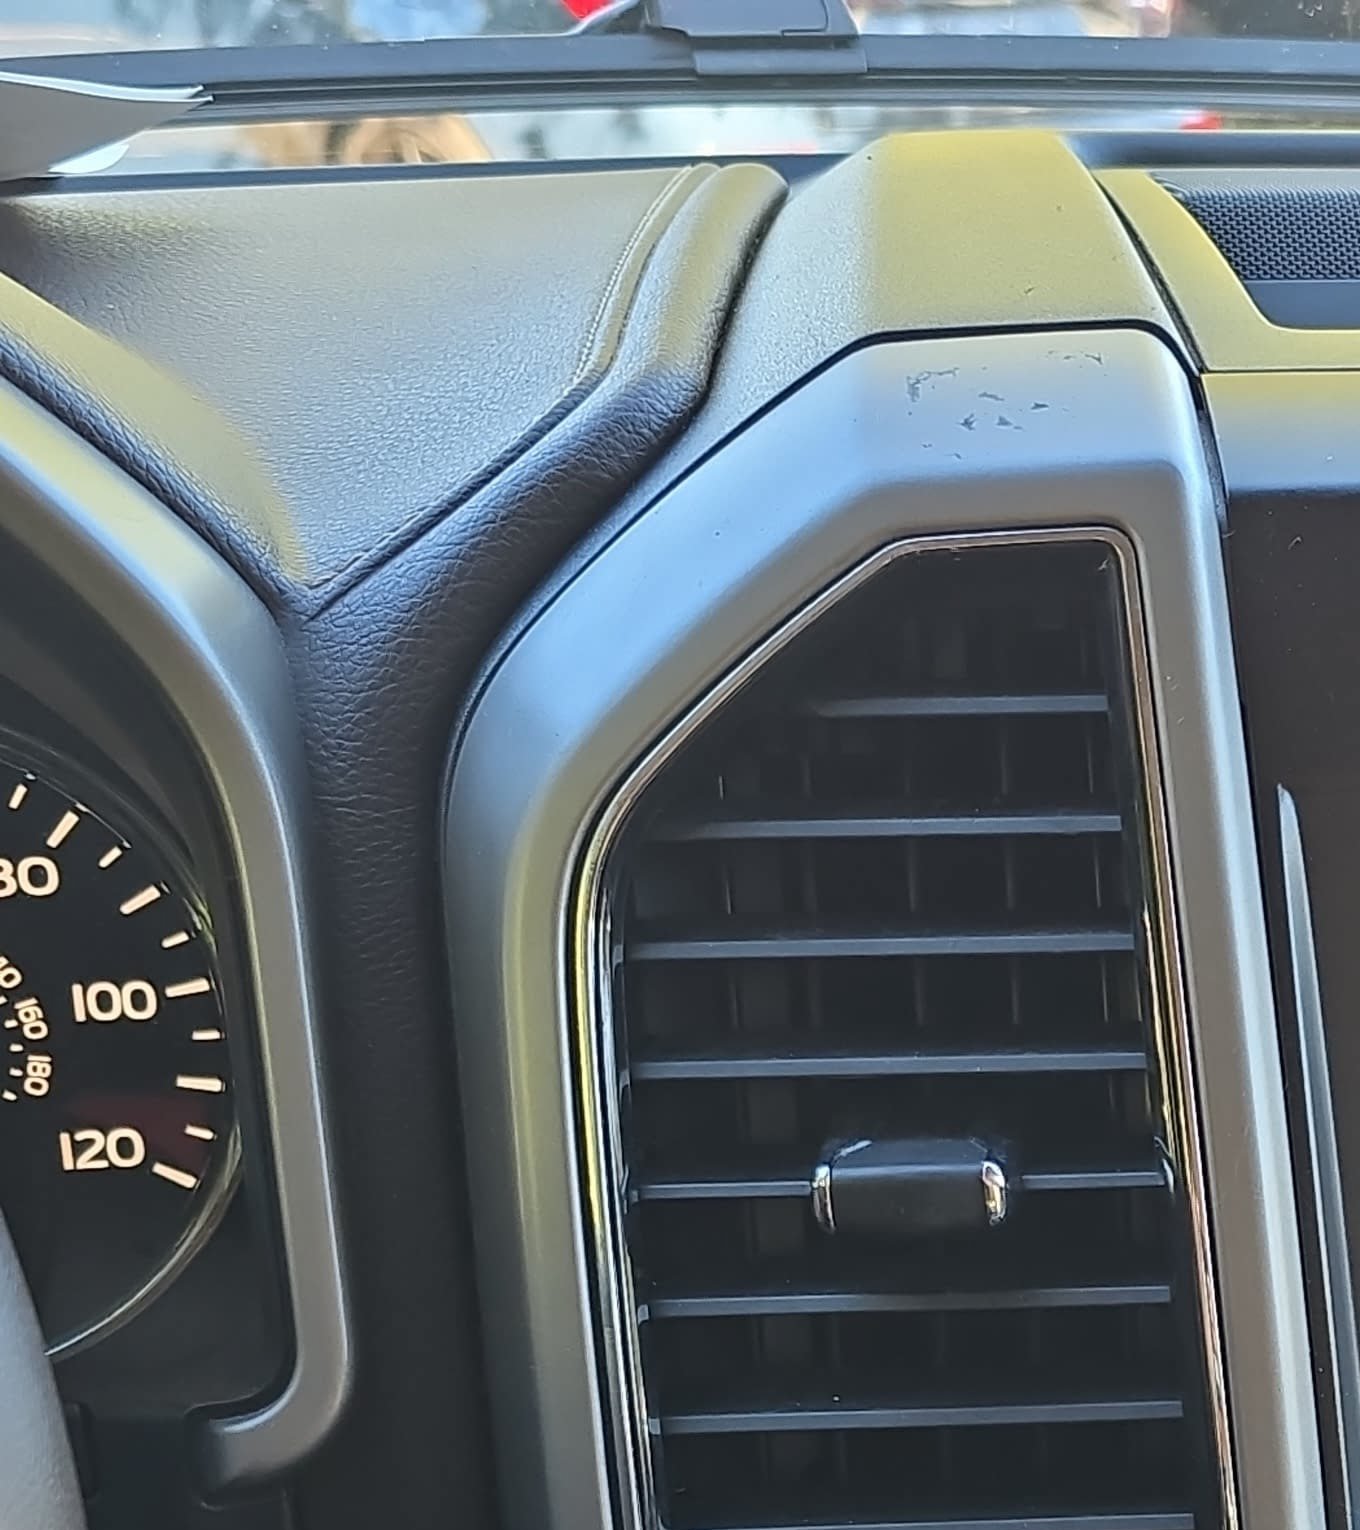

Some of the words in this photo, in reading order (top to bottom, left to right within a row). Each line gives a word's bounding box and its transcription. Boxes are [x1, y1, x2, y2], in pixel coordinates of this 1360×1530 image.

[13, 996, 49, 1040] 160
[71, 980, 158, 1023] 100
[23, 1054, 52, 1096] 180
[59, 1127, 146, 1172] 120
